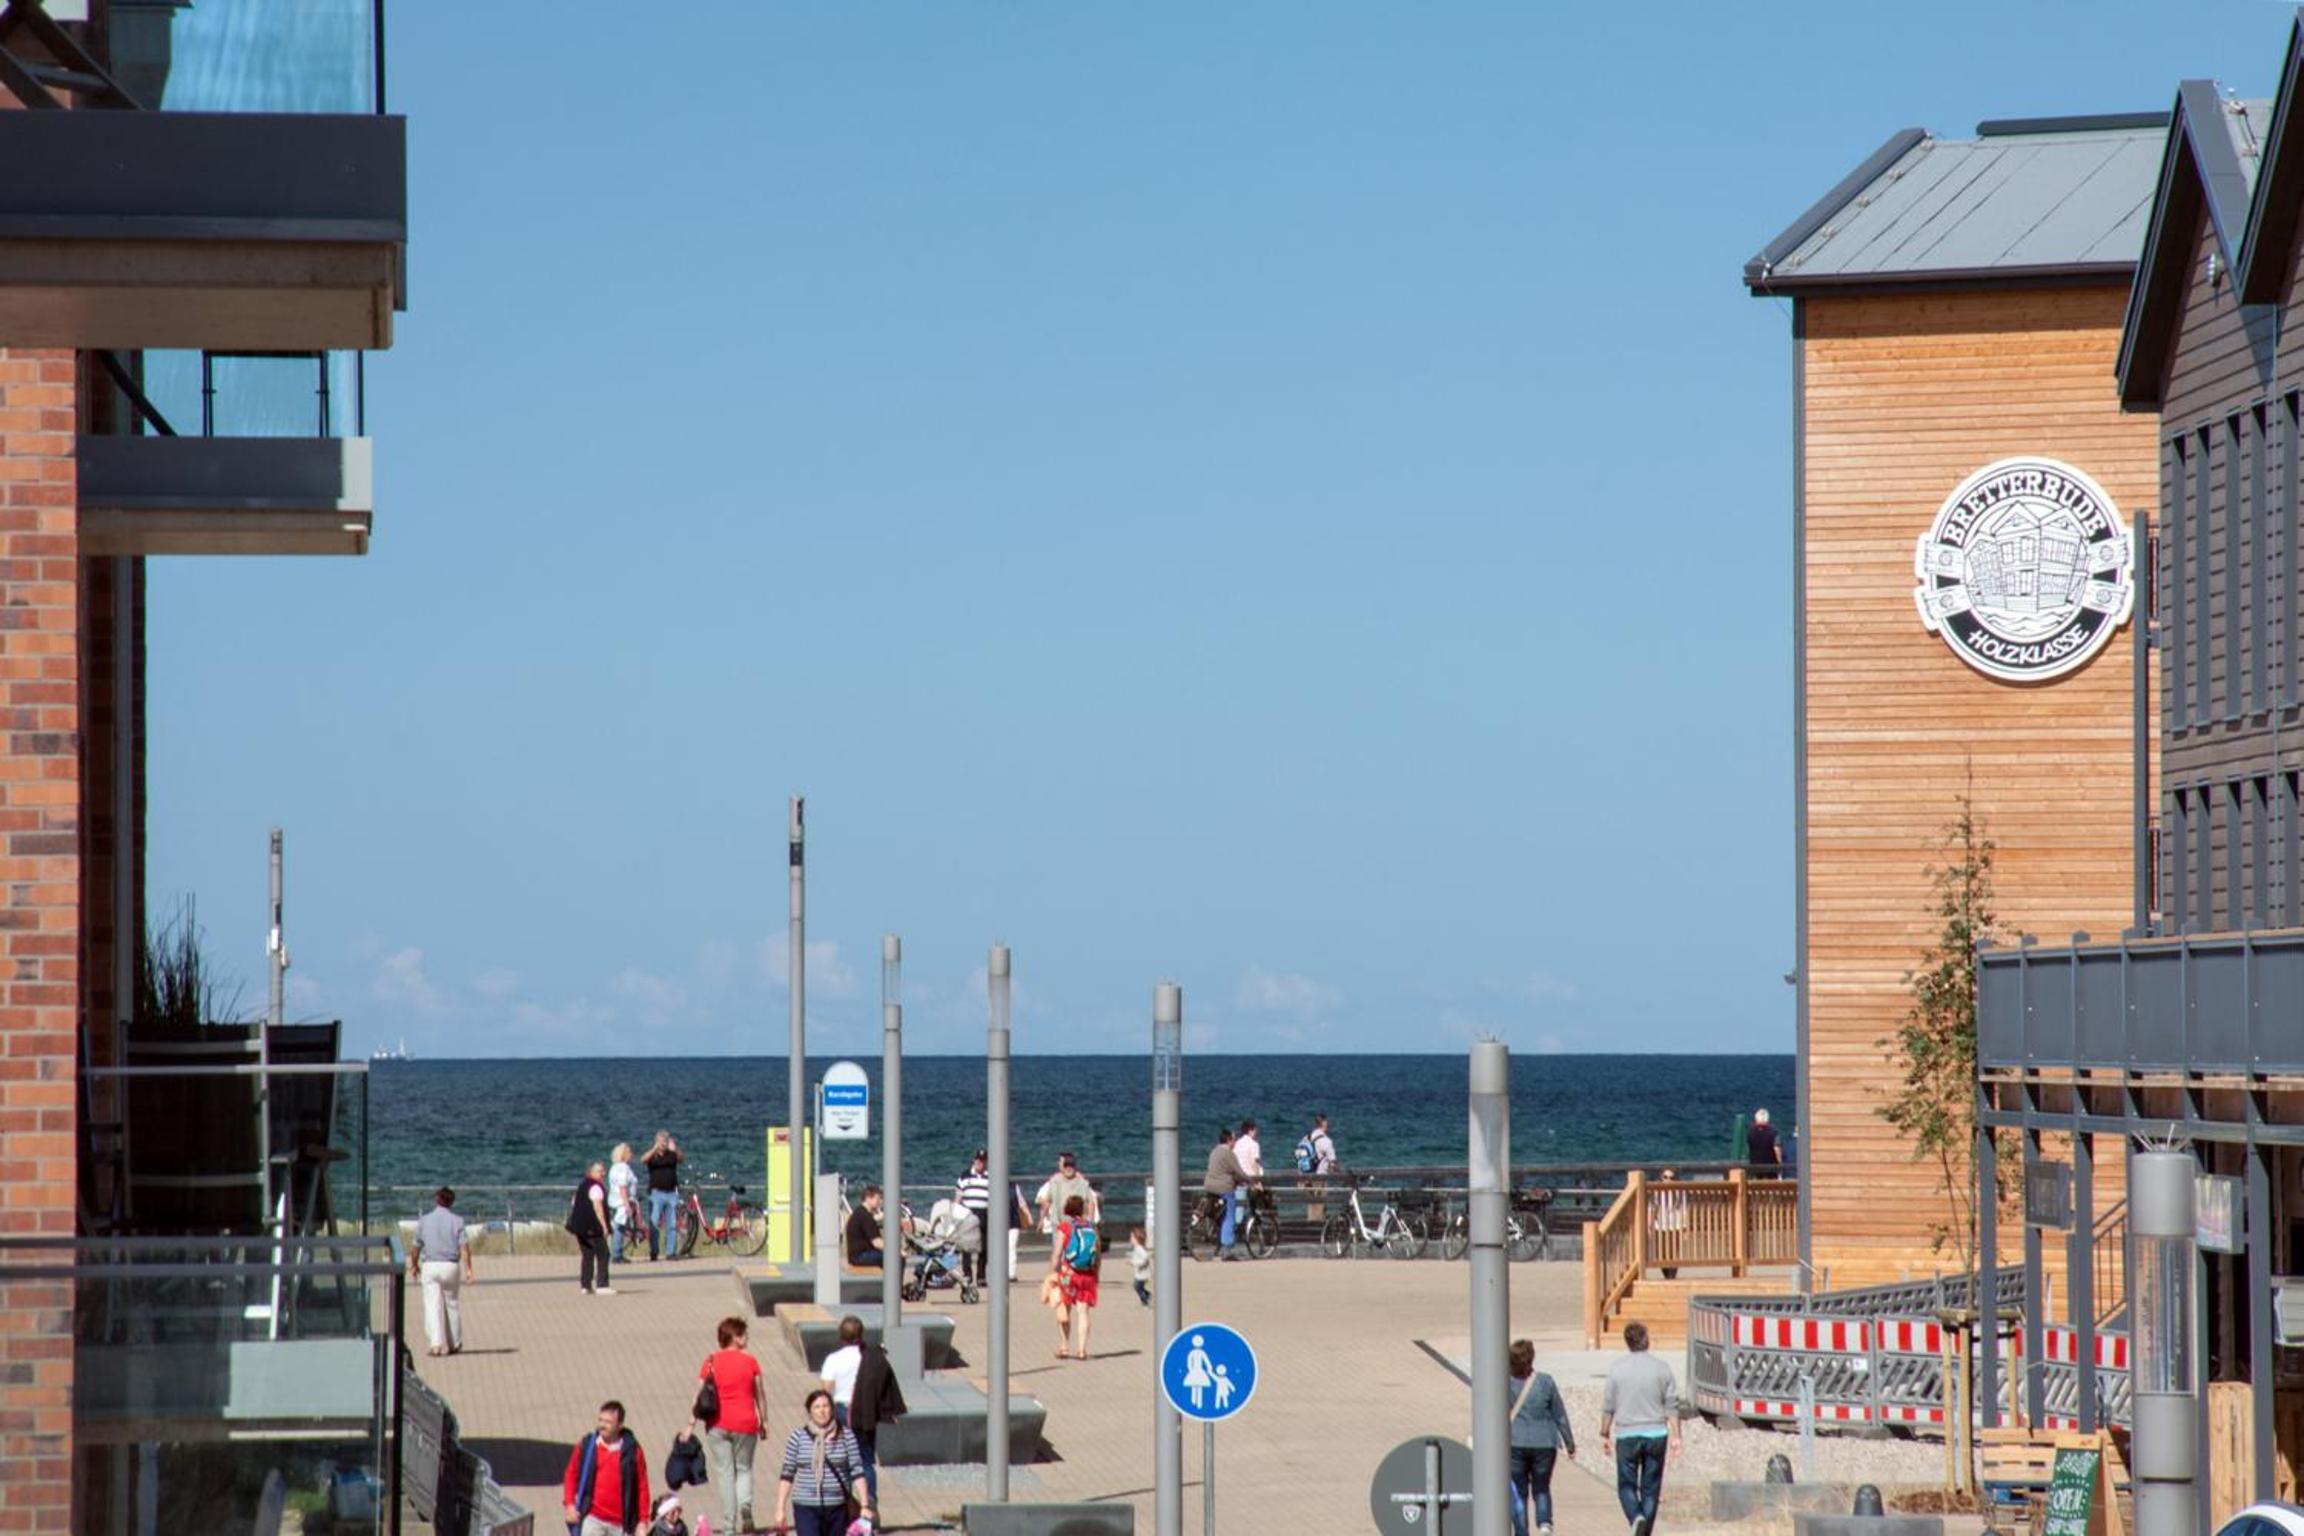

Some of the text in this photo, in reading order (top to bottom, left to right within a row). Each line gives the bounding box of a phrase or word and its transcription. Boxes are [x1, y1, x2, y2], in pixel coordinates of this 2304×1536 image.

[1945, 471, 2105, 544] BRETTERBUDE
[1968, 624, 2089, 664] HOLZKLASSE
[2053, 1488, 2083, 1511] OPEN
